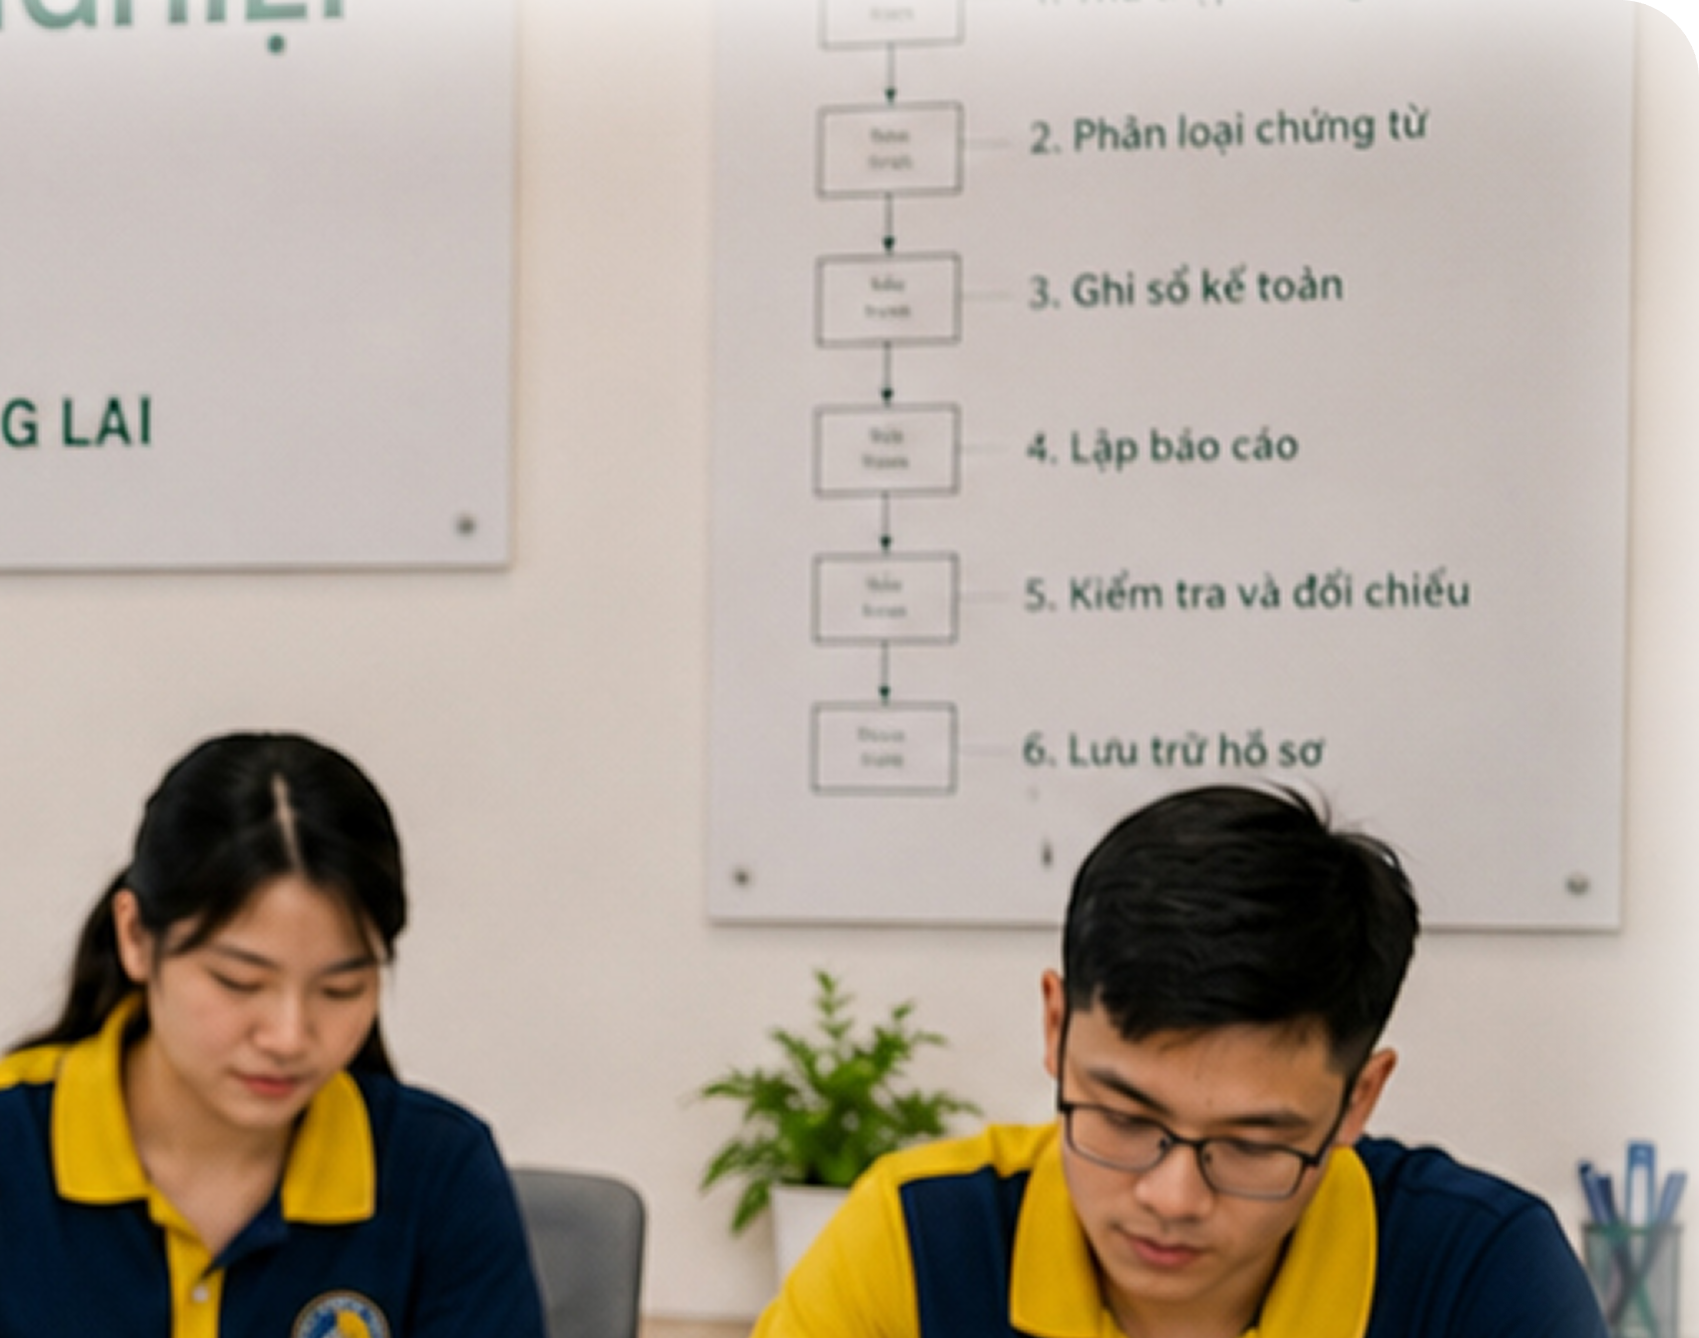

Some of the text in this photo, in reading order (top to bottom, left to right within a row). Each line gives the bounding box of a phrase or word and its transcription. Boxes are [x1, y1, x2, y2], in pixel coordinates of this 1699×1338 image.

[1029, 120, 1062, 155] 2.
[1028, 274, 1062, 312] 3.
[1071, 270, 1135, 309] Ghi
[61, 395, 152, 448] LAI
[1026, 432, 1057, 465] 4.
[1023, 576, 1057, 613] 5.
[1175, 578, 1227, 611] tra
[1237, 572, 1281, 610] và
[1021, 731, 1057, 768] 6.
